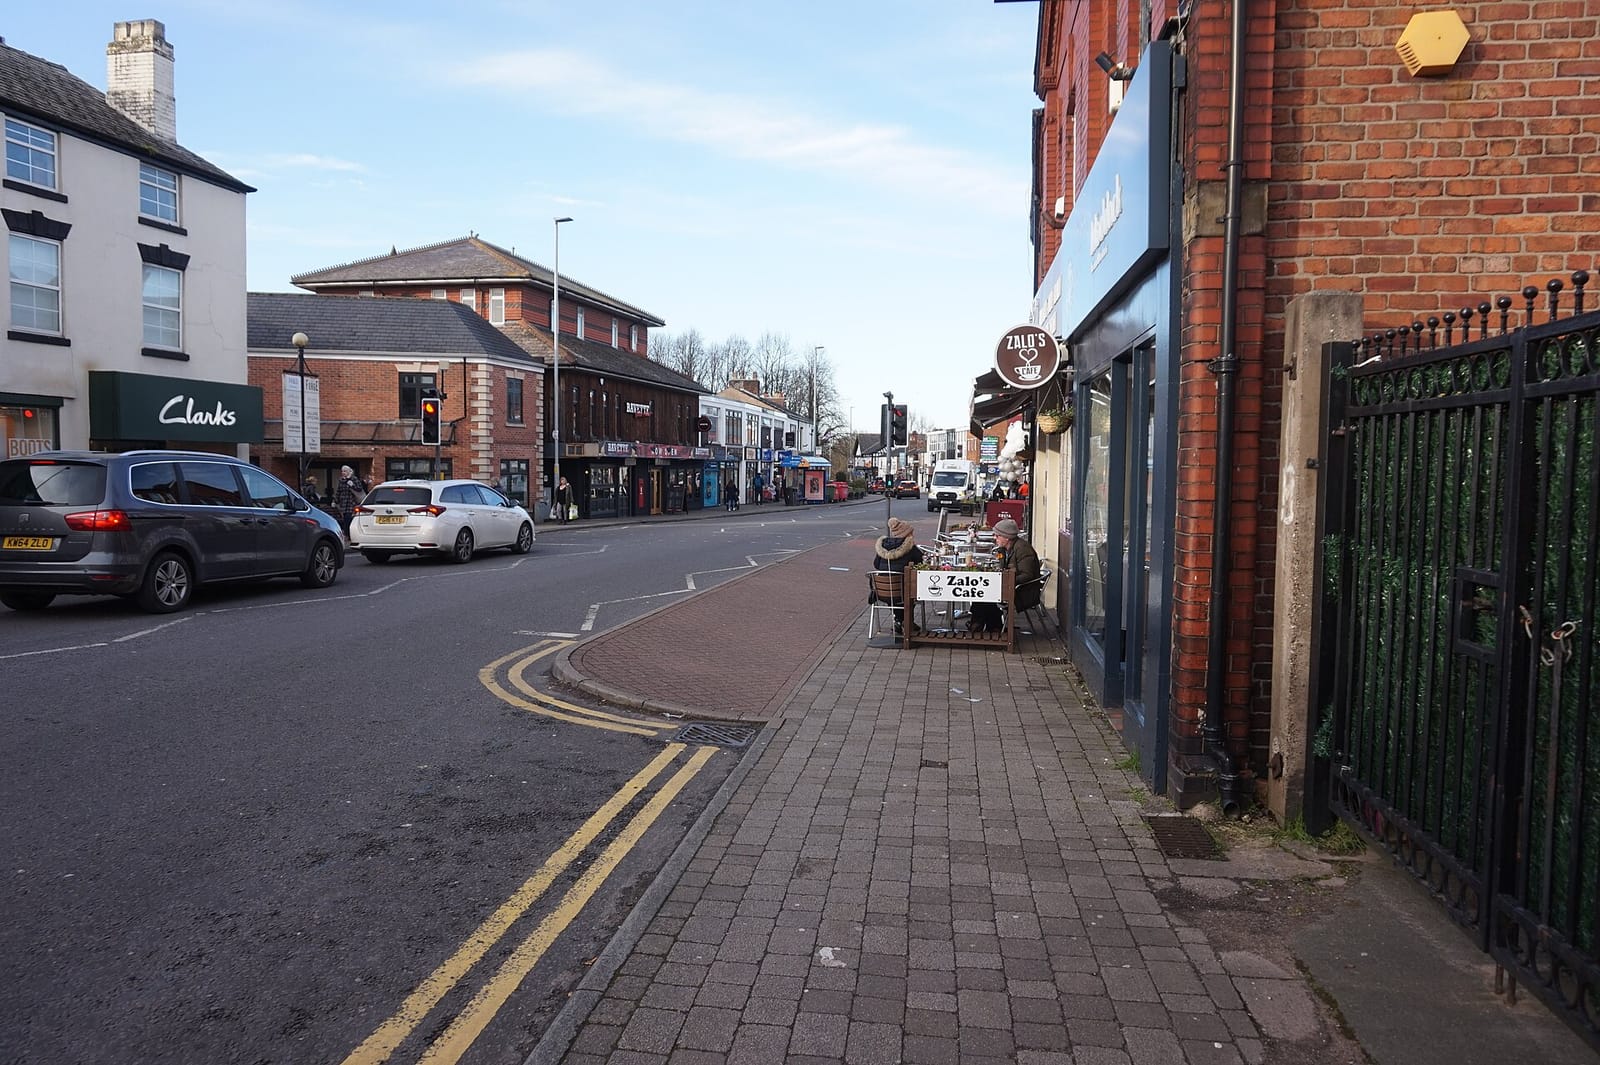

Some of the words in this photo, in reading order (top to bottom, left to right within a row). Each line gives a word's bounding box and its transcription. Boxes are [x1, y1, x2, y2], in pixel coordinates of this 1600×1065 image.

[1006, 333, 1046, 350] ZALO'S
[1021, 366, 1038, 375] CAFE
[158, 394, 237, 426] Clarks
[7, 537, 29, 548] KW64
[30, 538, 49, 548] ZLO
[946, 575, 990, 587] Zalo's
[951, 586, 985, 598] Cafe
